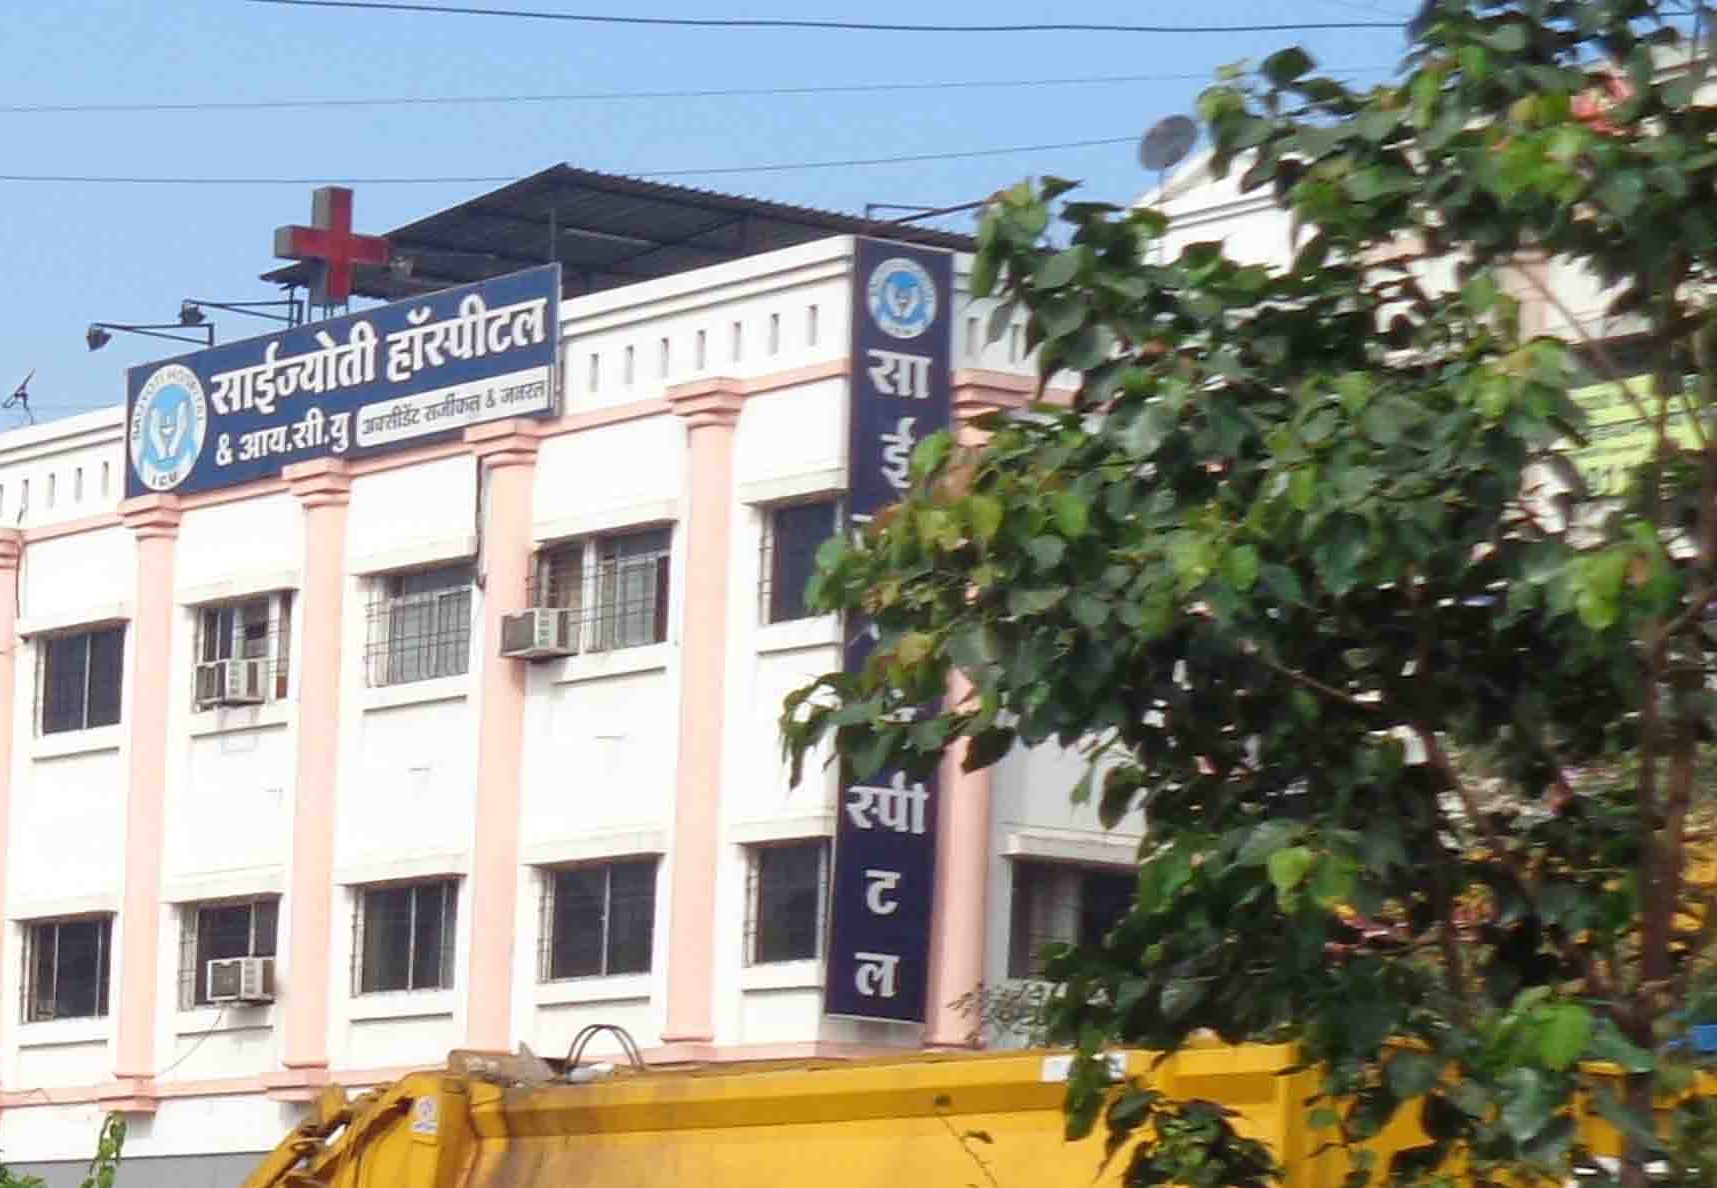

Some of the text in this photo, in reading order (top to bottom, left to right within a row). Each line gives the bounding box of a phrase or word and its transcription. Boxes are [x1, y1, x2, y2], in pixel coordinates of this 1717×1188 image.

[210, 294, 550, 417] साईज्योती हॉस्पीटल
[485, 388, 496, 408] &
[215, 433, 233, 466] &
